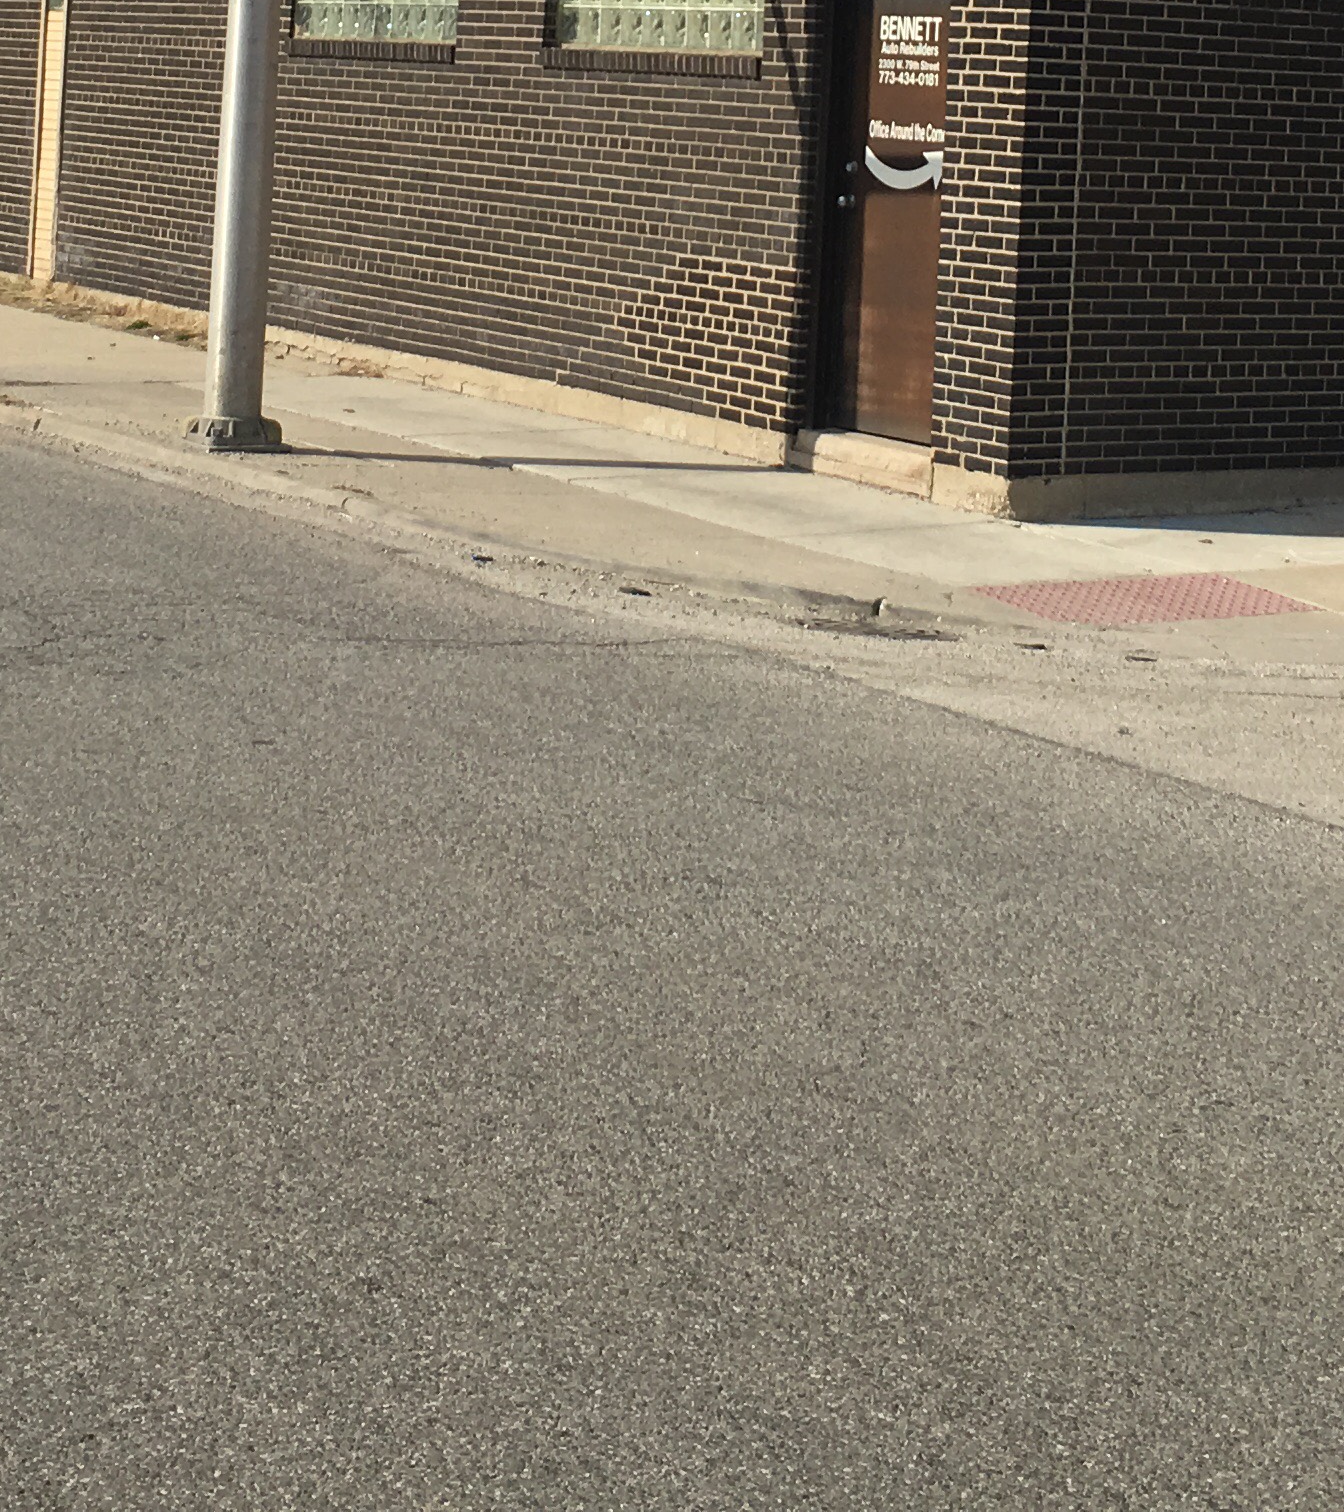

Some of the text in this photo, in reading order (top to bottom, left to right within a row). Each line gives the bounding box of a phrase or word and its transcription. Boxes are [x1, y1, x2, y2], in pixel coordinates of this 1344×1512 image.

[880, 15, 943, 41] BENNETT
[881, 41, 939, 57] Auto Rebuilders
[878, 70, 939, 86] 773-434-0181
[869, 119, 889, 139] Office
[890, 120, 914, 141] Around
[914, 122, 925, 142] the
